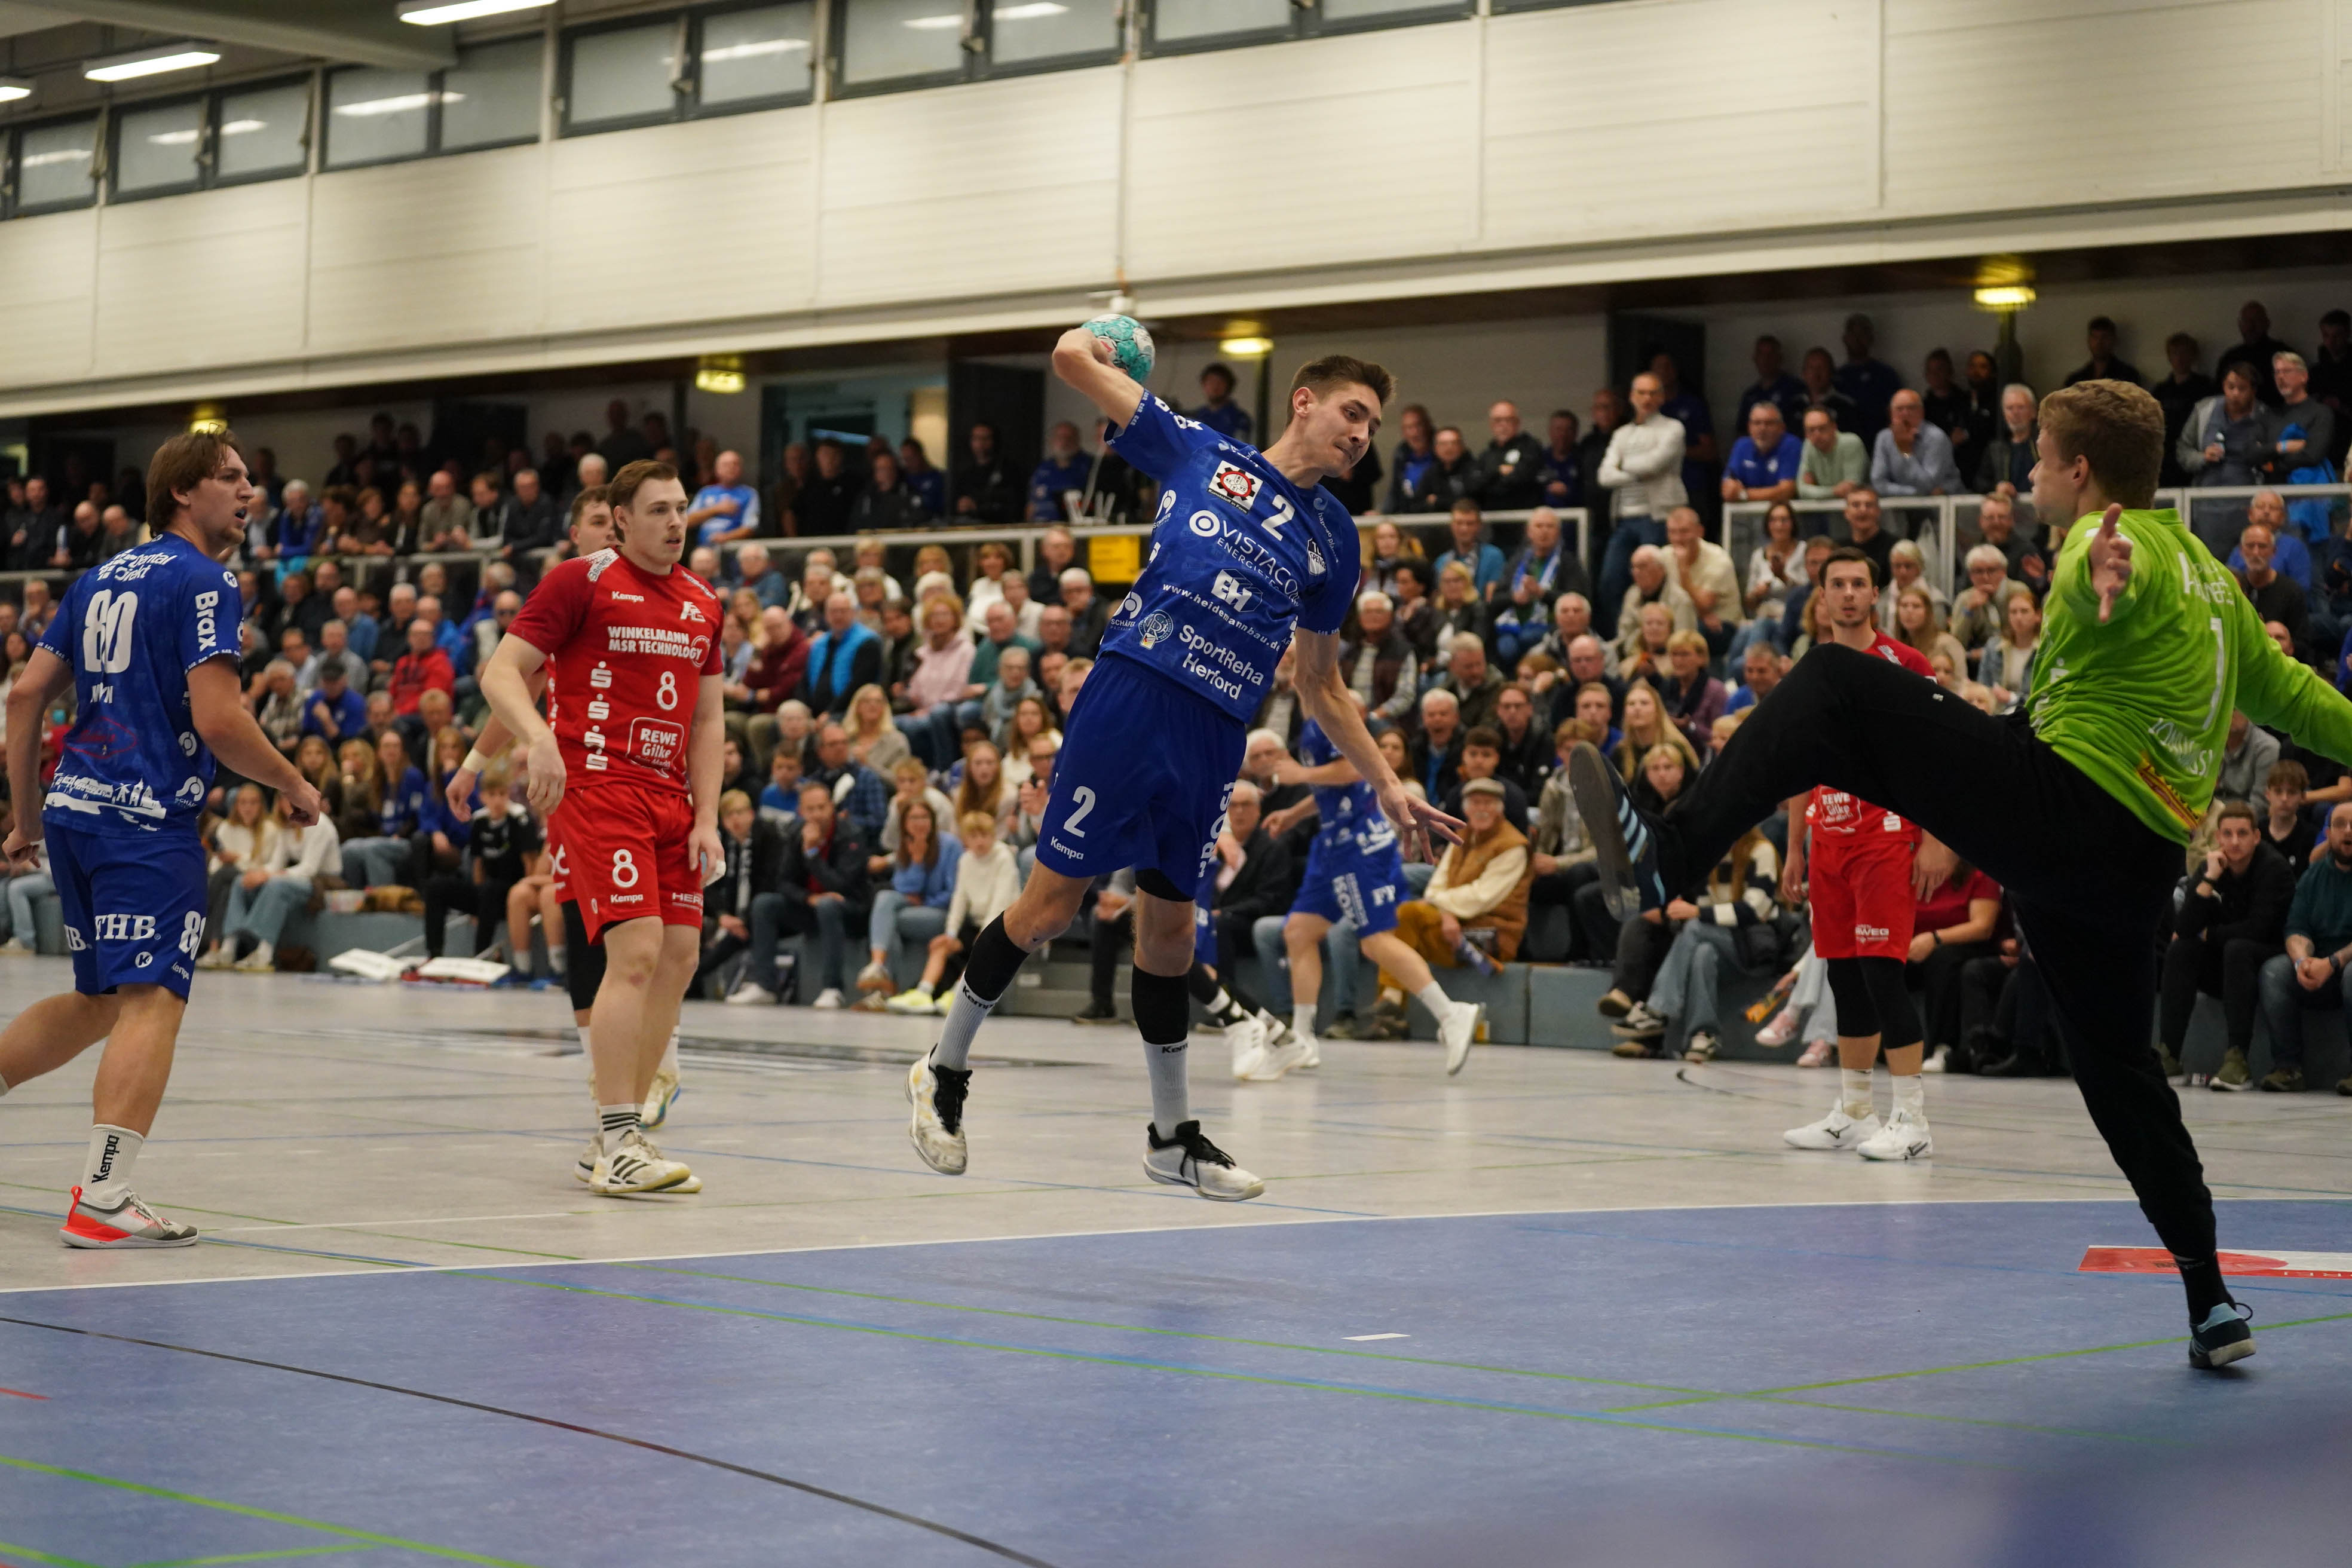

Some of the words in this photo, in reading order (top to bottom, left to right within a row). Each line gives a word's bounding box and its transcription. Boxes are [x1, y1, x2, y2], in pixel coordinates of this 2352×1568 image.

[1154, 396, 1203, 430] Bax
[1261, 494, 1295, 541] 2
[611, 591, 644, 603] Kempa
[82, 589, 139, 673] 80
[195, 590, 219, 652] Brax
[608, 626, 690, 645] WINKELMANN
[609, 639, 636, 653] MSR
[639, 641, 703, 660] TECHNOLOGY
[1179, 624, 1264, 685] SportReha
[657, 671, 678, 710] 8
[1183, 653, 1242, 700] Herford
[640, 728, 678, 746] REWE
[642, 743, 672, 758] Gilke
[1064, 786, 1096, 838] 2
[1822, 792, 1851, 806] REWE
[1051, 836, 1085, 860] Kempa
[612, 849, 639, 889] 8
[610, 893, 643, 904] Kempa
[91, 1134, 120, 1184] Kempa
